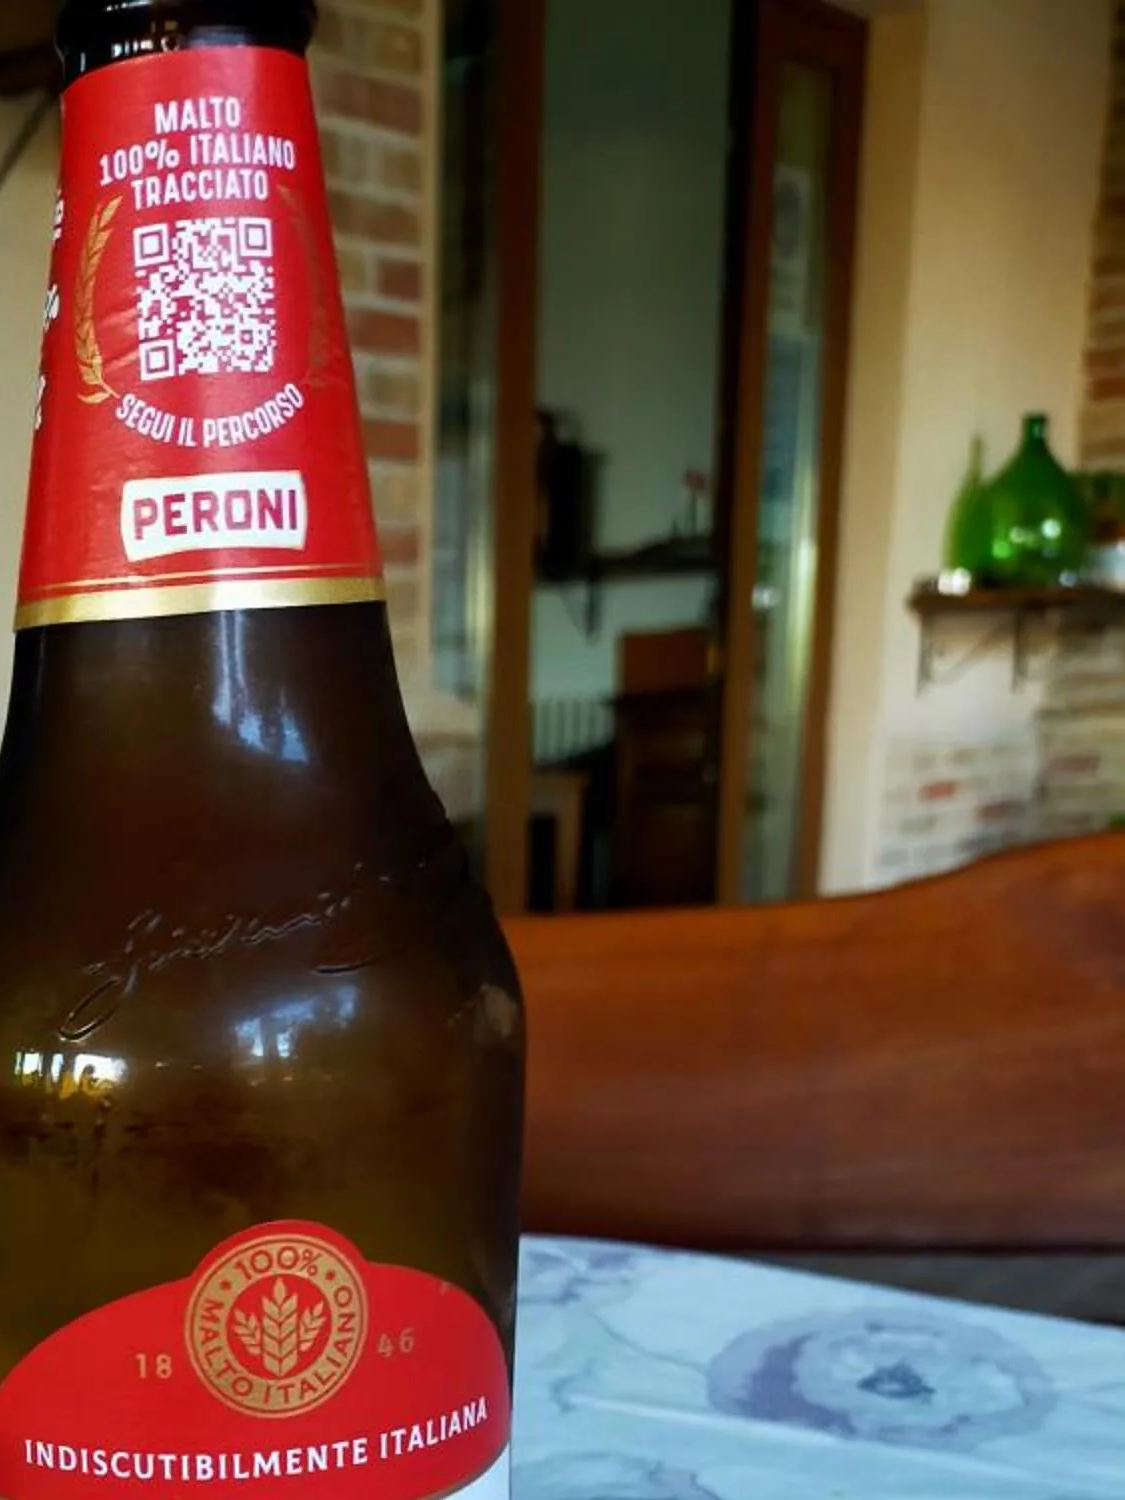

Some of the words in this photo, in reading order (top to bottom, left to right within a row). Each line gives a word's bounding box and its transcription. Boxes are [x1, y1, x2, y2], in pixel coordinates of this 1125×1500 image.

[154, 97, 241, 134] MALTO
[100, 139, 181, 186] 100%
[191, 133, 296, 170] ITALIANO
[132, 169, 268, 210] TRACCIATO
[116, 394, 175, 443] SEGUI
[178, 417, 197, 447] IL
[202, 383, 305, 448] PERCORSO
[133, 489, 298, 540] PERONI
[233, 1246, 321, 1281] 100%
[136, 1353, 173, 1380] 18
[376, 1327, 416, 1358] 46
[200, 1299, 254, 1399] MALTO
[263, 1285, 357, 1404] ITALIANO
[25, 1437, 368, 1481] INDISCUTIBILMENTE
[378, 1396, 488, 1459] ITALIANA
